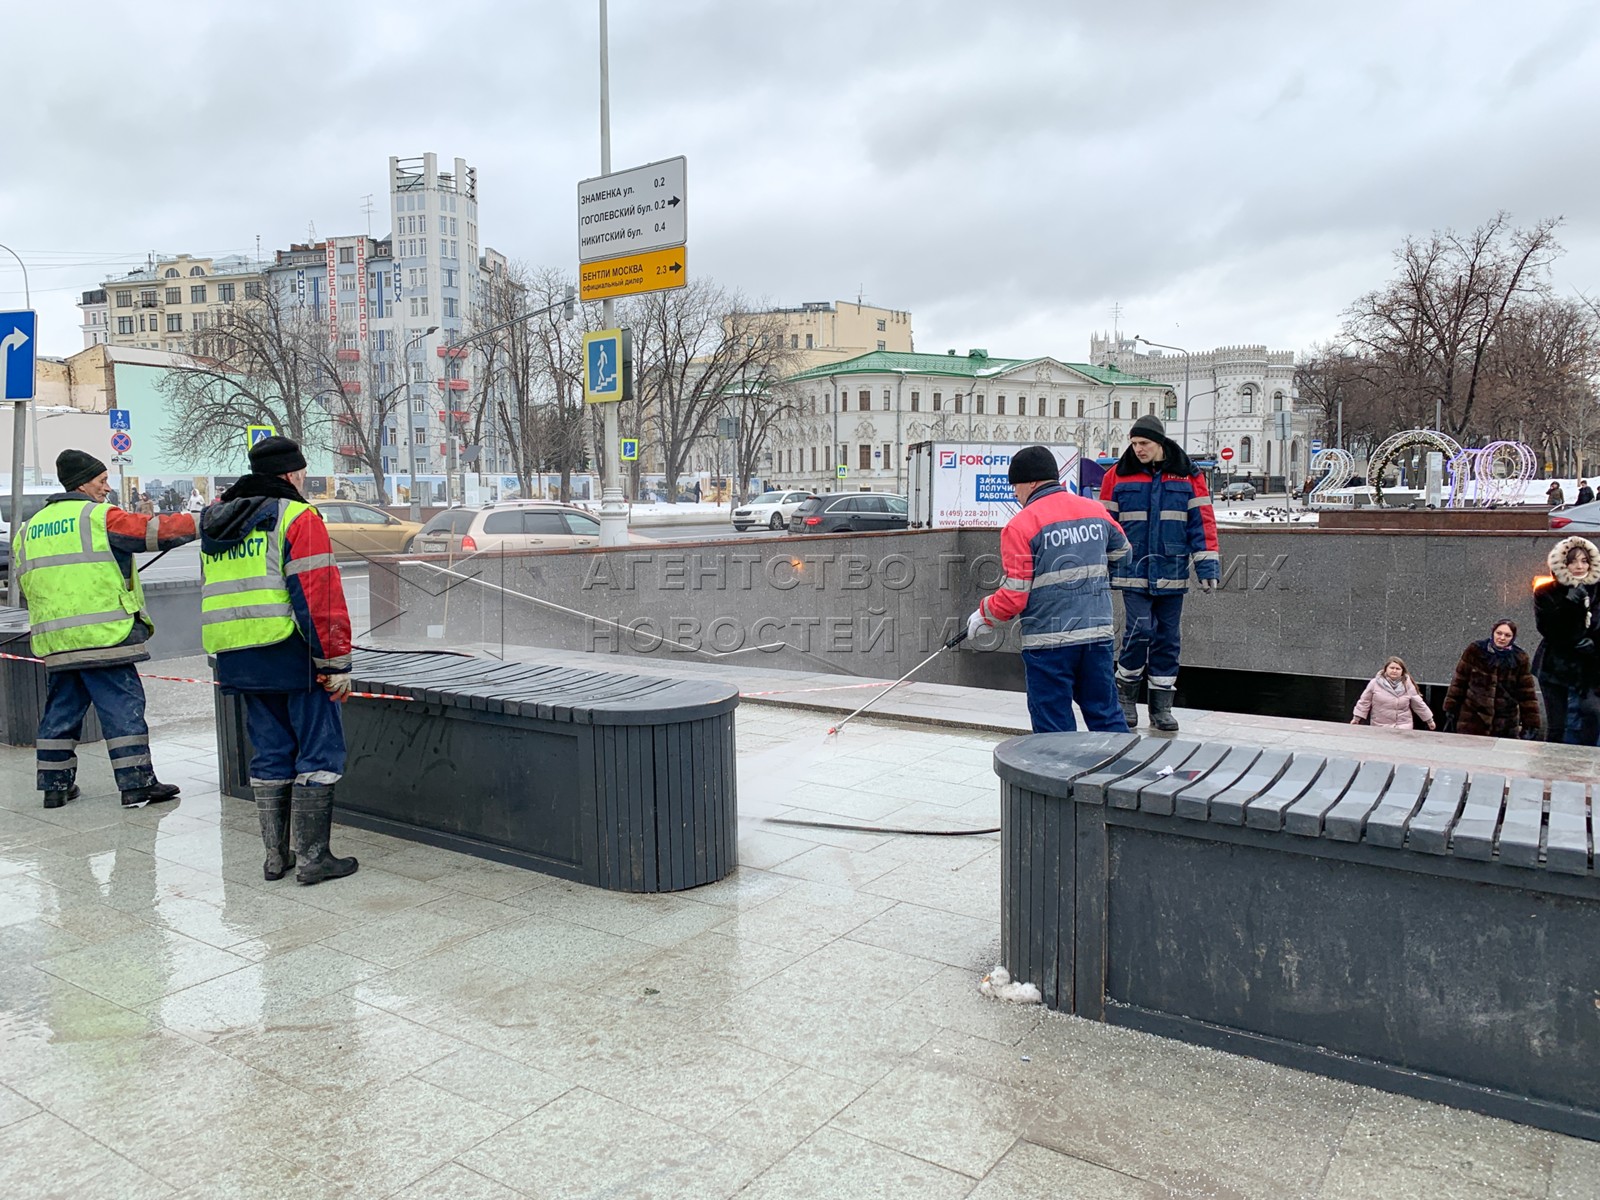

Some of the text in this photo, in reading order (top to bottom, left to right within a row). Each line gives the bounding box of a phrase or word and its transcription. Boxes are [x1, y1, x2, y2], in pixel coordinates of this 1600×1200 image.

[581, 177, 665, 205] ЗНАМЕНКА ул. 0.2
[581, 199, 666, 226] ГОГОЛЕВСКИЙ бул. 0.2
[581, 222, 666, 247] НИКИТСКИЙ бул. 0.4
[393, 262, 402, 303] МСНХ
[582, 264, 667, 282] БЕНТЛИ МОСКВА 2.3
[582, 276, 644, 293] официальный дилер
[357, 238, 367, 342] МОССЕЛЬПРОМ
[959, 455, 1012, 466] FOROFFI
[979, 492, 1017, 500] РАБОТАЕ
[945, 510, 964, 518] (495)
[26, 517, 76, 542] ГОРМОСТ
[1043, 523, 1105, 549] ГОРМОСТ
